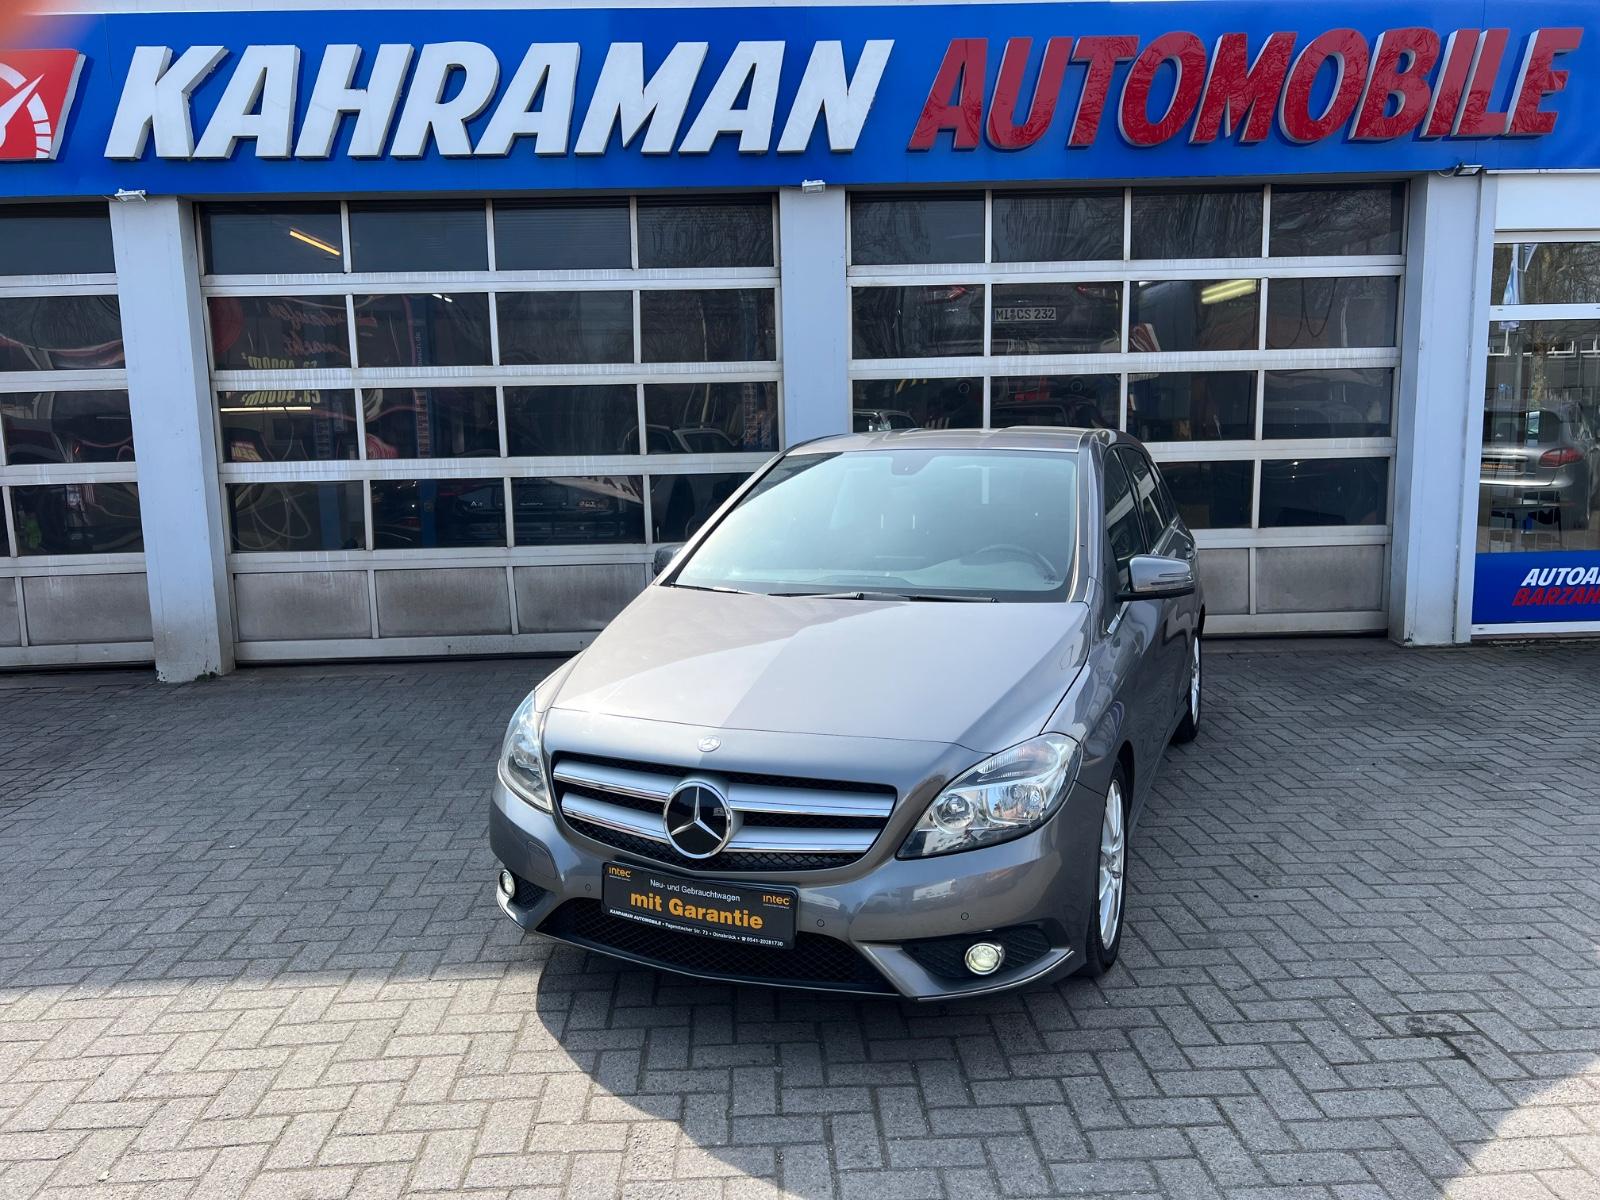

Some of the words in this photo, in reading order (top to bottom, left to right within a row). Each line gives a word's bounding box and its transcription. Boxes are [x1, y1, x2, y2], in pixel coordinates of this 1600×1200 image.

[104, 39, 895, 161] KAHRAMAN
[907, 26, 1585, 152] AUTOMOBILE
[996, 309, 1010, 320] MI
[1016, 309, 1031, 320] CS
[1034, 309, 1055, 320] 232
[1521, 567, 1600, 586] AUTOA
[608, 866, 631, 878] intec
[650, 879, 666, 889] Neu-
[667, 883, 680, 892] und
[681, 885, 740, 903] Gebrauchtwagen
[762, 894, 790, 905] intec
[630, 892, 662, 912] mit
[668, 898, 764, 929] Garantie
